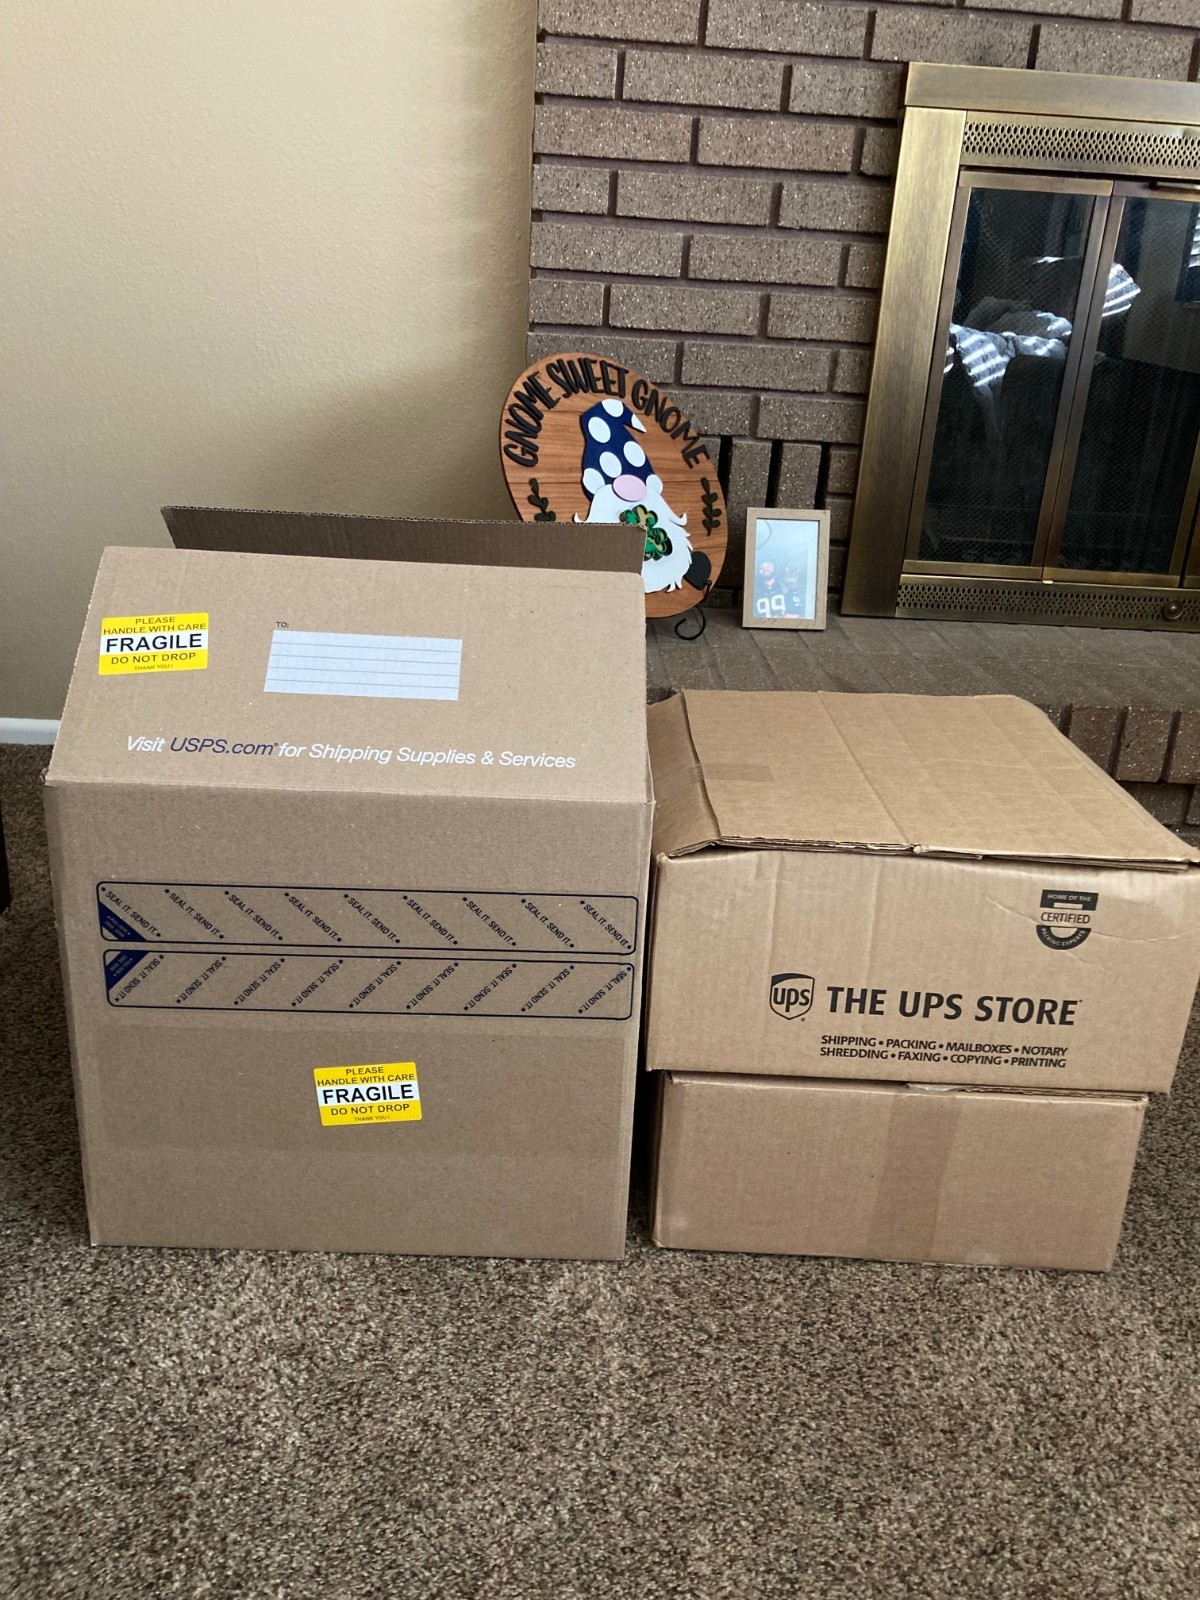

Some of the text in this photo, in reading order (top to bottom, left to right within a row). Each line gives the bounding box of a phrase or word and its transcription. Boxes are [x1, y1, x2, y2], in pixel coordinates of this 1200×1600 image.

[503, 357, 711, 470] GNOME SWEET GNOME
[757, 594, 786, 618] 99
[135, 616, 176, 625] PLEASE
[103, 622, 206, 636] HANDLE WITH CARE
[106, 633, 203, 653] FRAGILE
[110, 652, 196, 665] DO NOT DROP
[127, 736, 166, 752] Visit
[278, 742, 306, 758] for
[309, 744, 392, 764] Shipping
[397, 747, 476, 766] Supplies
[481, 751, 494, 766] &
[499, 751, 576, 768] Services
[106, 891, 122, 907] SEAL
[122, 905, 132, 914] IT.
[131, 912, 149, 928] SEND
[148, 926, 157, 935] IT.
[169, 893, 220, 937] SEAL IT. SEND IT.
[229, 895, 279, 939] SEAL IT. SEND IT.
[289, 896, 338, 939] SEAL IT. SEND IT.
[348, 898, 396, 941] SEAL IT. SEND IT.
[407, 900, 454, 942] SEAL IT. SEND IT.
[1040, 912, 1091, 924] CERTIFIED
[466, 901, 513, 945] SEAL IT. SEND IT.
[525, 902, 571, 946] SEAL IT. SEND IT.
[584, 904, 628, 948] SEAL IT. SEND IT.
[1041, 928, 1061, 946] PACKING
[144, 958, 160, 972] SEAL
[208, 960, 222, 974] SEAL
[264, 962, 281, 976] SEAL
[323, 963, 339, 977] SEAL
[380, 964, 397, 979] SEAL
[438, 966, 454, 980] SEAL
[499, 968, 512, 981] SEAL
[556, 970, 570, 982] SEAL
[613, 971, 627, 984] SEAL
[125, 978, 140, 993] SEND
[186, 979, 202, 995] SEND
[244, 981, 260, 996] SEND
[301, 982, 318, 998] SEND
[359, 984, 376, 999] SEND
[416, 984, 433, 1000] SEND
[474, 987, 491, 1002] SEND
[532, 988, 548, 1004] SEND
[589, 989, 605, 1005] SEND
[773, 986, 1079, 1026] ups THE UPS STORE
[820, 1035, 1068, 1056] SHIPPING PACKING MAILBOXES NOTARY
[820, 1046, 1067, 1068] SHREDDING FAXING COPYING PRINTING
[346, 1066, 384, 1076] PLEASE
[317, 1074, 415, 1086] HANDLE WITH CARE
[322, 1084, 414, 1104] FRAGILE
[330, 1104, 410, 1116] DO NOT DROP
